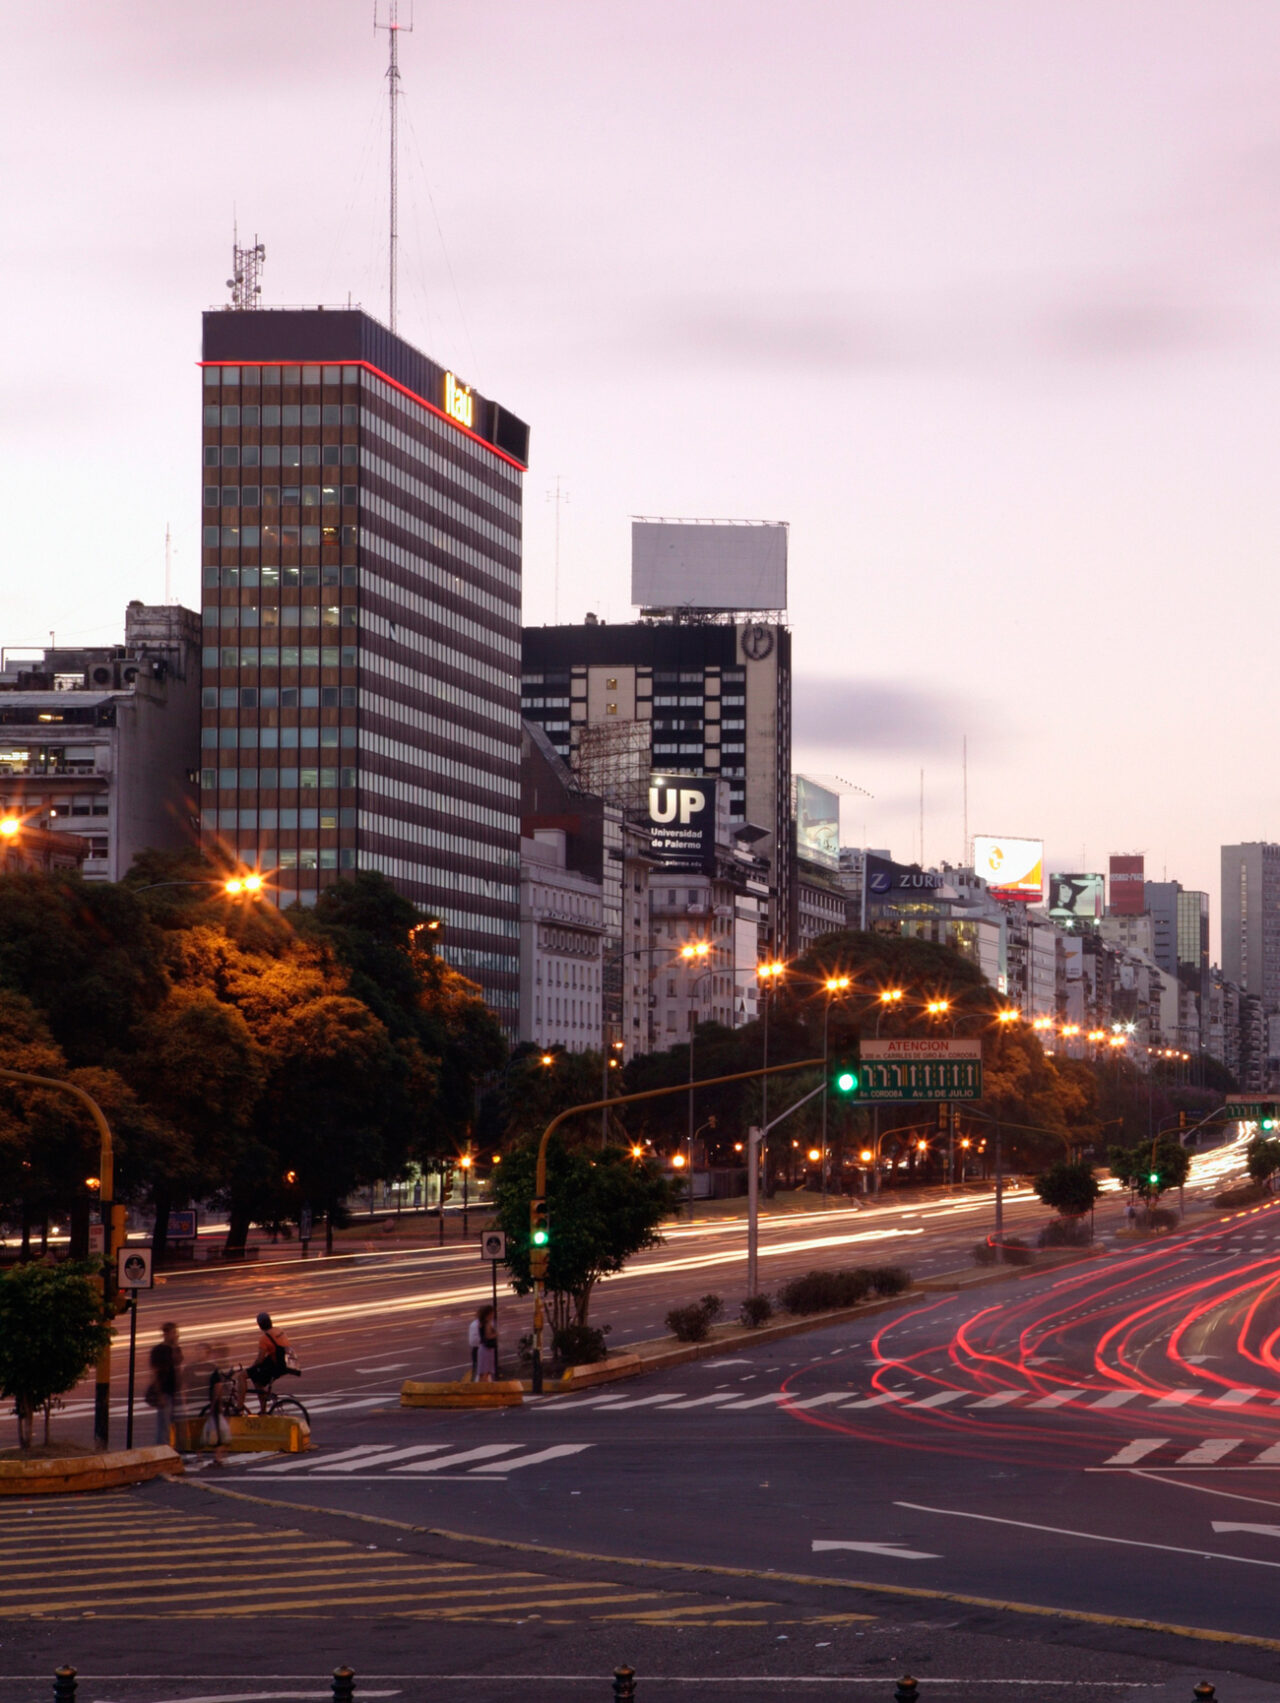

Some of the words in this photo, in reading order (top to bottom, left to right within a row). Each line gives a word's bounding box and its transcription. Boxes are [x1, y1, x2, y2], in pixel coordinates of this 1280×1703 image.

[446, 371, 472, 428] Itaú
[649, 787, 706, 824] UP
[650, 827, 703, 839] Universidad
[651, 839, 663, 848] de
[664, 839, 702, 849] Palermo
[948, 1089, 974, 1097] JULIO
